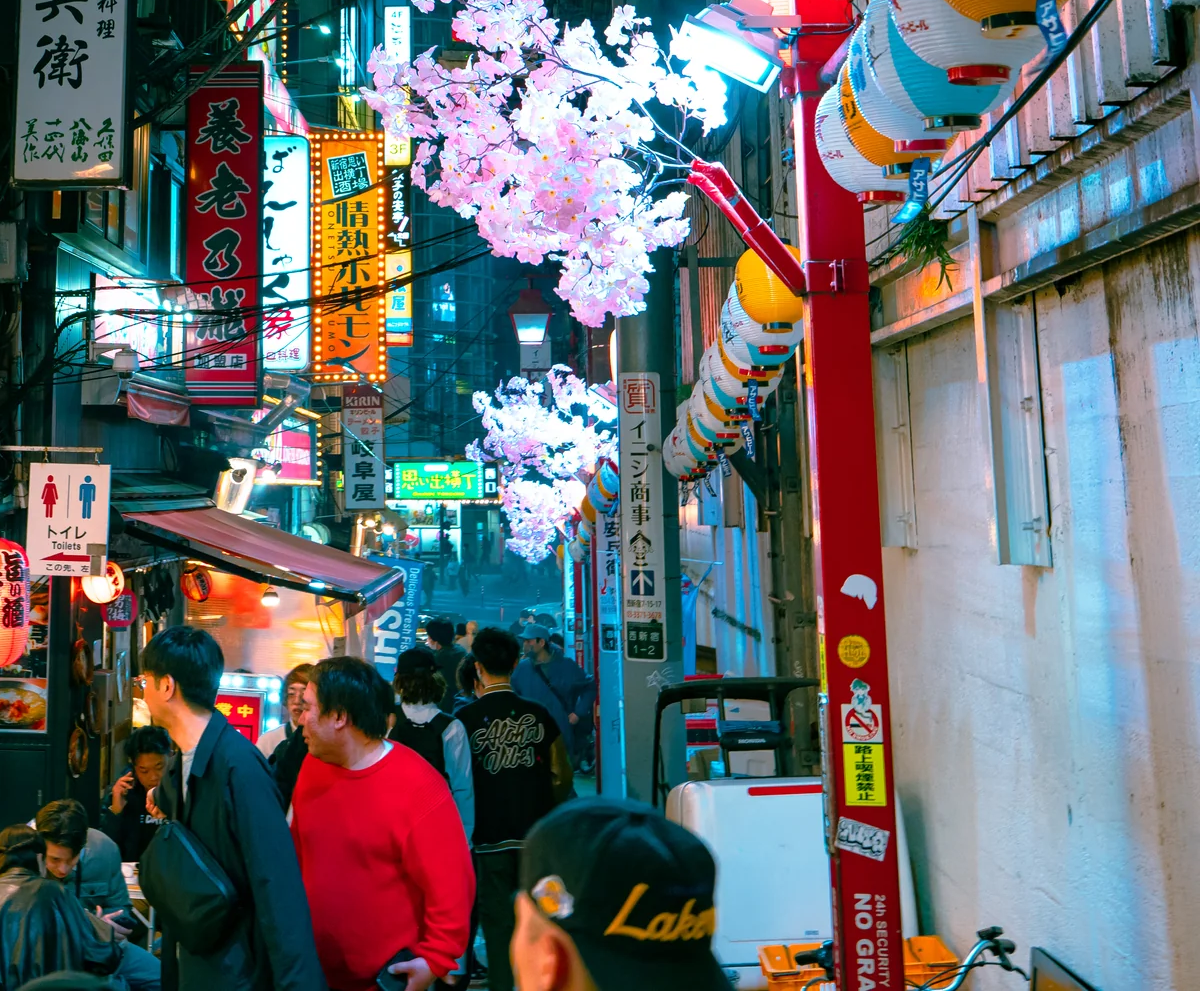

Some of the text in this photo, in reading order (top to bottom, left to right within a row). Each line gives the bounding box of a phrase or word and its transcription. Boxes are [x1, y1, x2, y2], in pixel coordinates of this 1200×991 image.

[41, 117, 66, 163] 十四代
[69, 117, 93, 163] 八海山
[93, 117, 116, 163] 久保田
[389, 144, 406, 155] 3F
[195, 98, 252, 343] 養老乃瀧
[195, 354, 244, 370] 加盟店
[627, 383, 650, 408] 質
[351, 439, 377, 503] 岐阜屋
[401, 469, 477, 490] 思い出横丁
[630, 420, 650, 526] イニシ商事
[46, 525, 87, 540] トイレ
[51, 541, 82, 551] Toilets
[1, 549, 25, 628] 旨い酒
[400, 567, 420, 653] Delicious Fresh Fis
[629, 630, 660, 642] 西新宿
[633, 645, 656, 655] 1-2
[470, 713, 545, 753] Aloha
[483, 744, 535, 774] Vibes
[854, 745, 876, 801] 路上喫煙禁止
[854, 893, 874, 930] NO
[874, 894, 891, 988] 24h SECURITY
